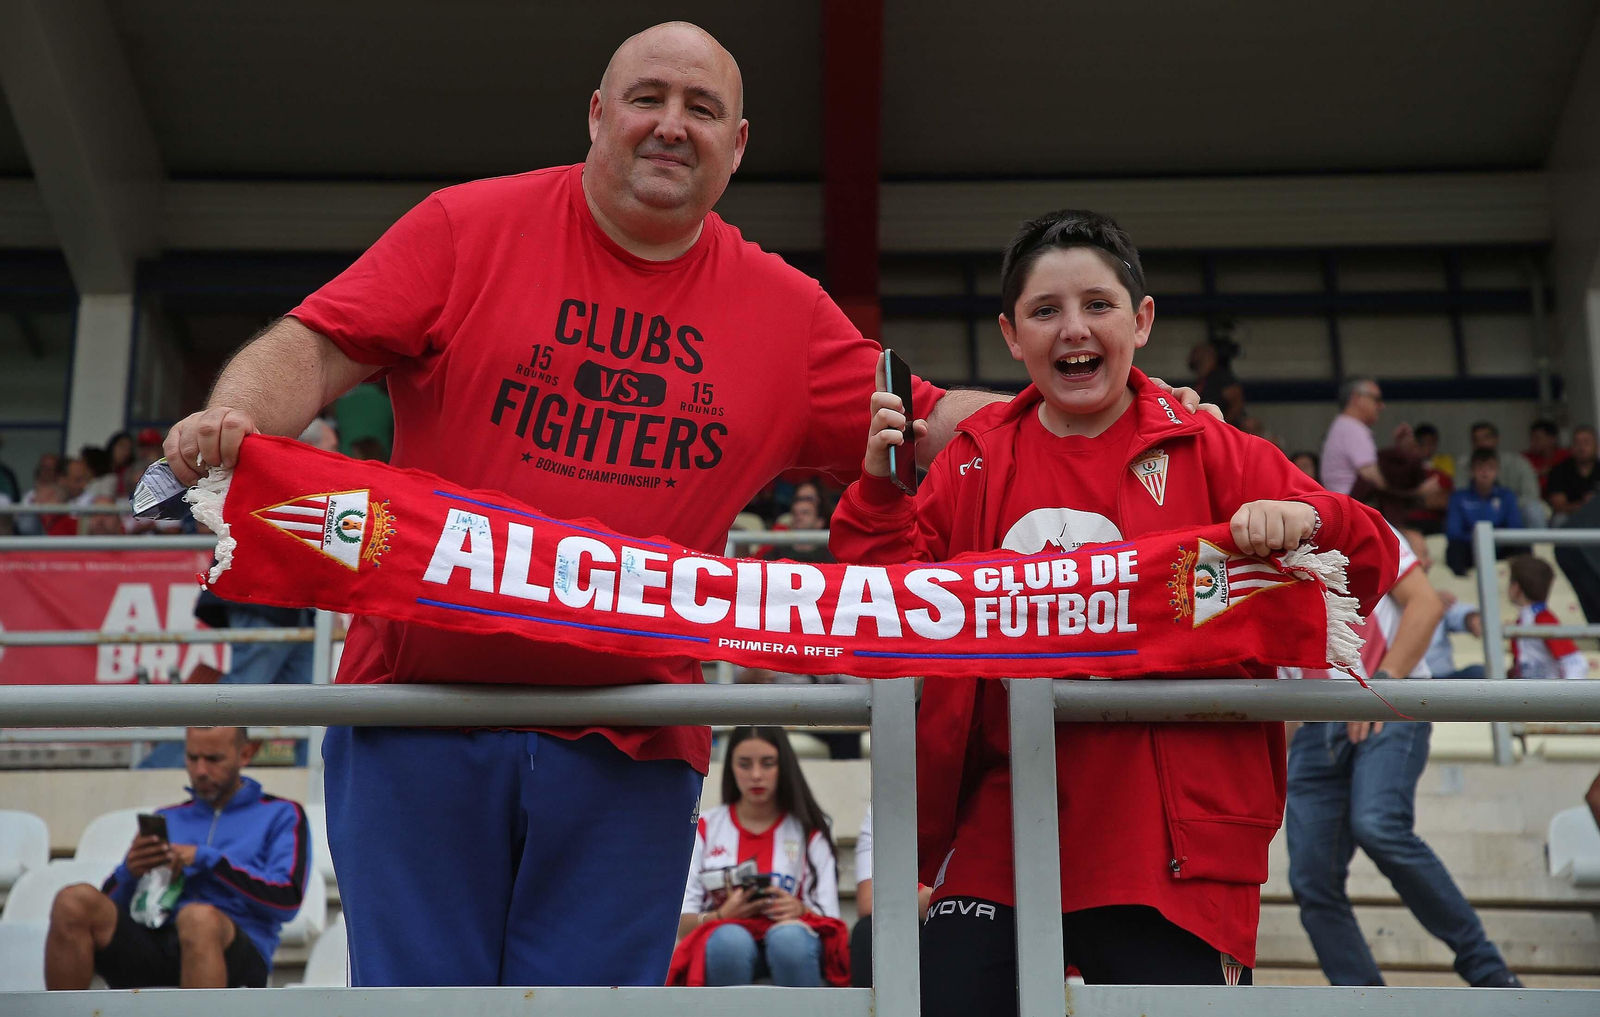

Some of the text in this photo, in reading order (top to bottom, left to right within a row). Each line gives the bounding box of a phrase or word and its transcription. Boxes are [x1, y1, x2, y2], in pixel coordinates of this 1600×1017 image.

[555, 299, 704, 374] CLUBS
[530, 344, 554, 371] 15
[515, 363, 559, 387] ROUNDS
[600, 370, 649, 404] VS.
[680, 401, 724, 417] ROUNDS
[691, 382, 714, 406] 15
[490, 378, 728, 470] FIGHTERS
[535, 457, 661, 489] BOXING CHAMPIONSHIP
[422, 508, 965, 640] ALGECIRAS
[974, 550, 1140, 592] CLUB DE
[974, 588, 1138, 639] FÚTBOL
[718, 637, 844, 658] PRIMERA RFEF
